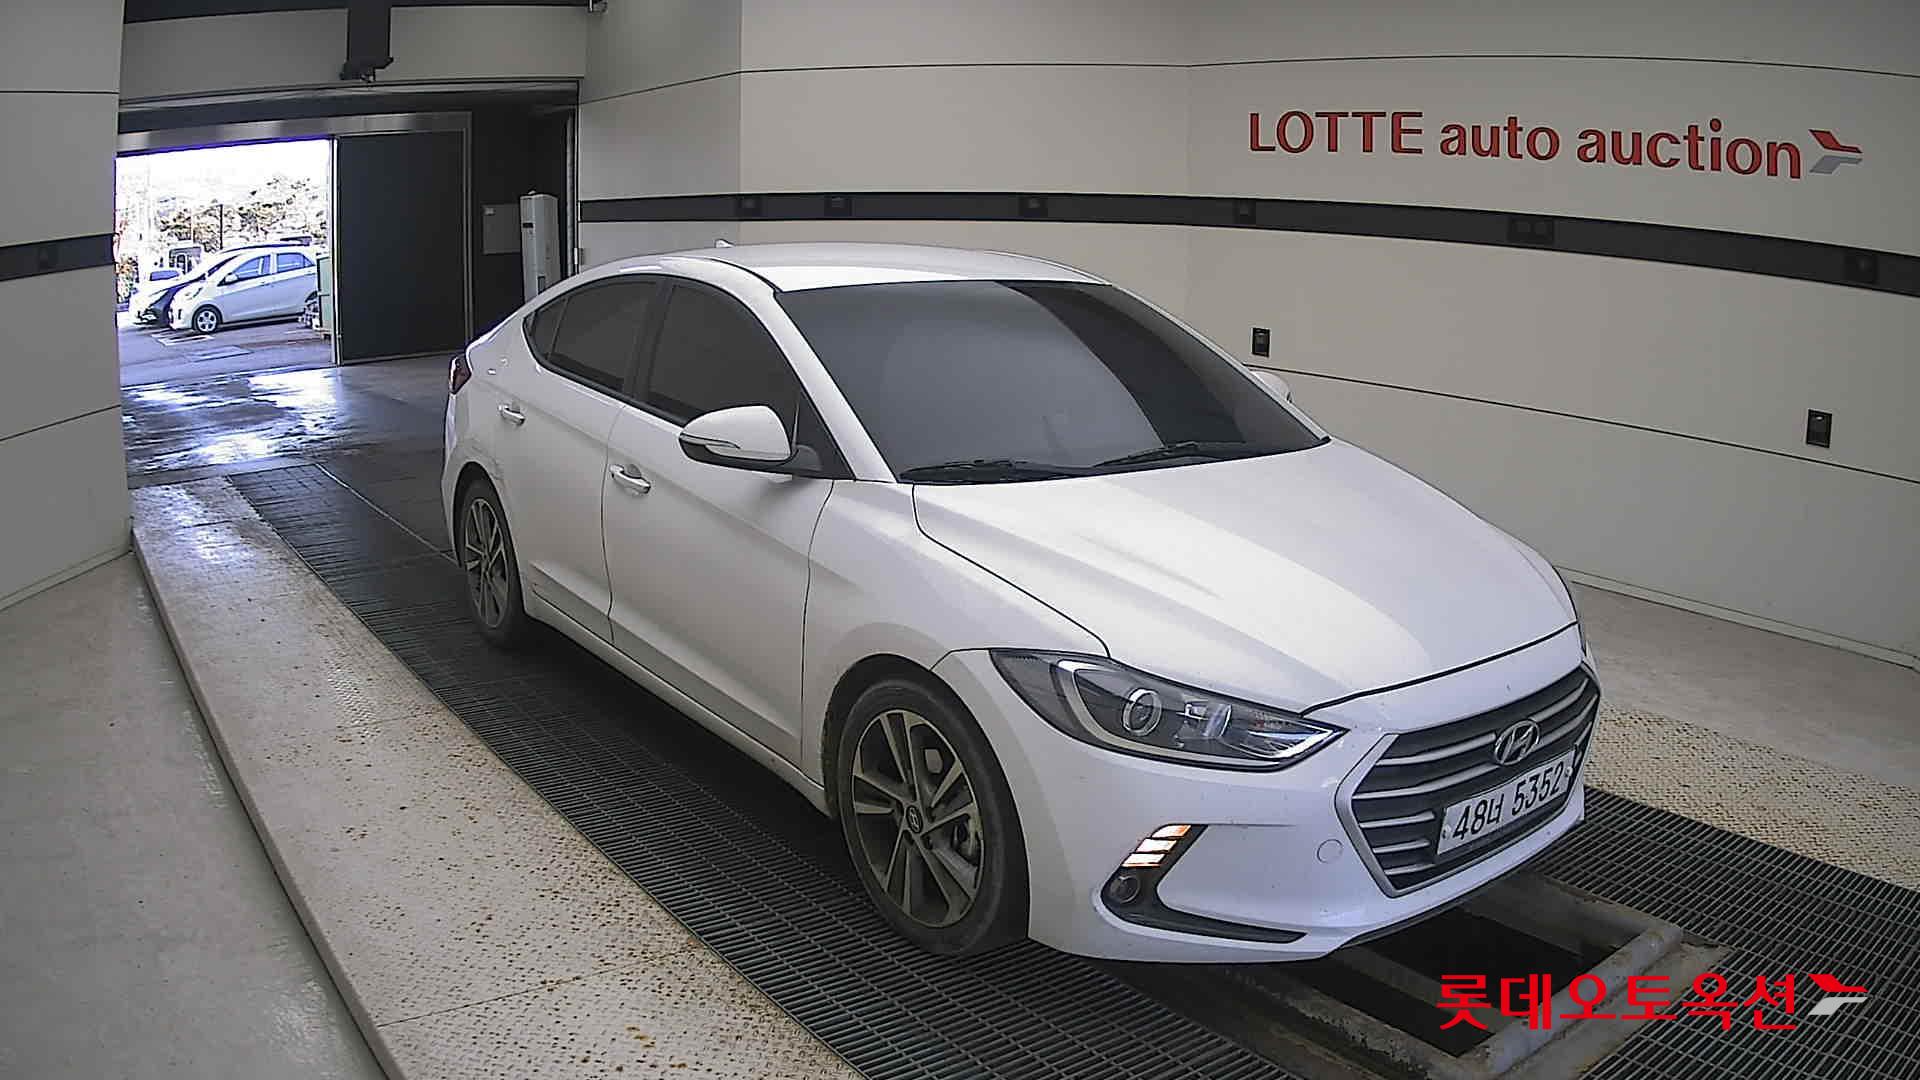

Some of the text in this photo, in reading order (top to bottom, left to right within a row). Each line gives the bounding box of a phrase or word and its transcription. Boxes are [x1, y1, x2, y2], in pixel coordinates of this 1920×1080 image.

[1249, 111, 1801, 179] LOTTE auto auction
[1452, 760, 1565, 840] 48너 5352
